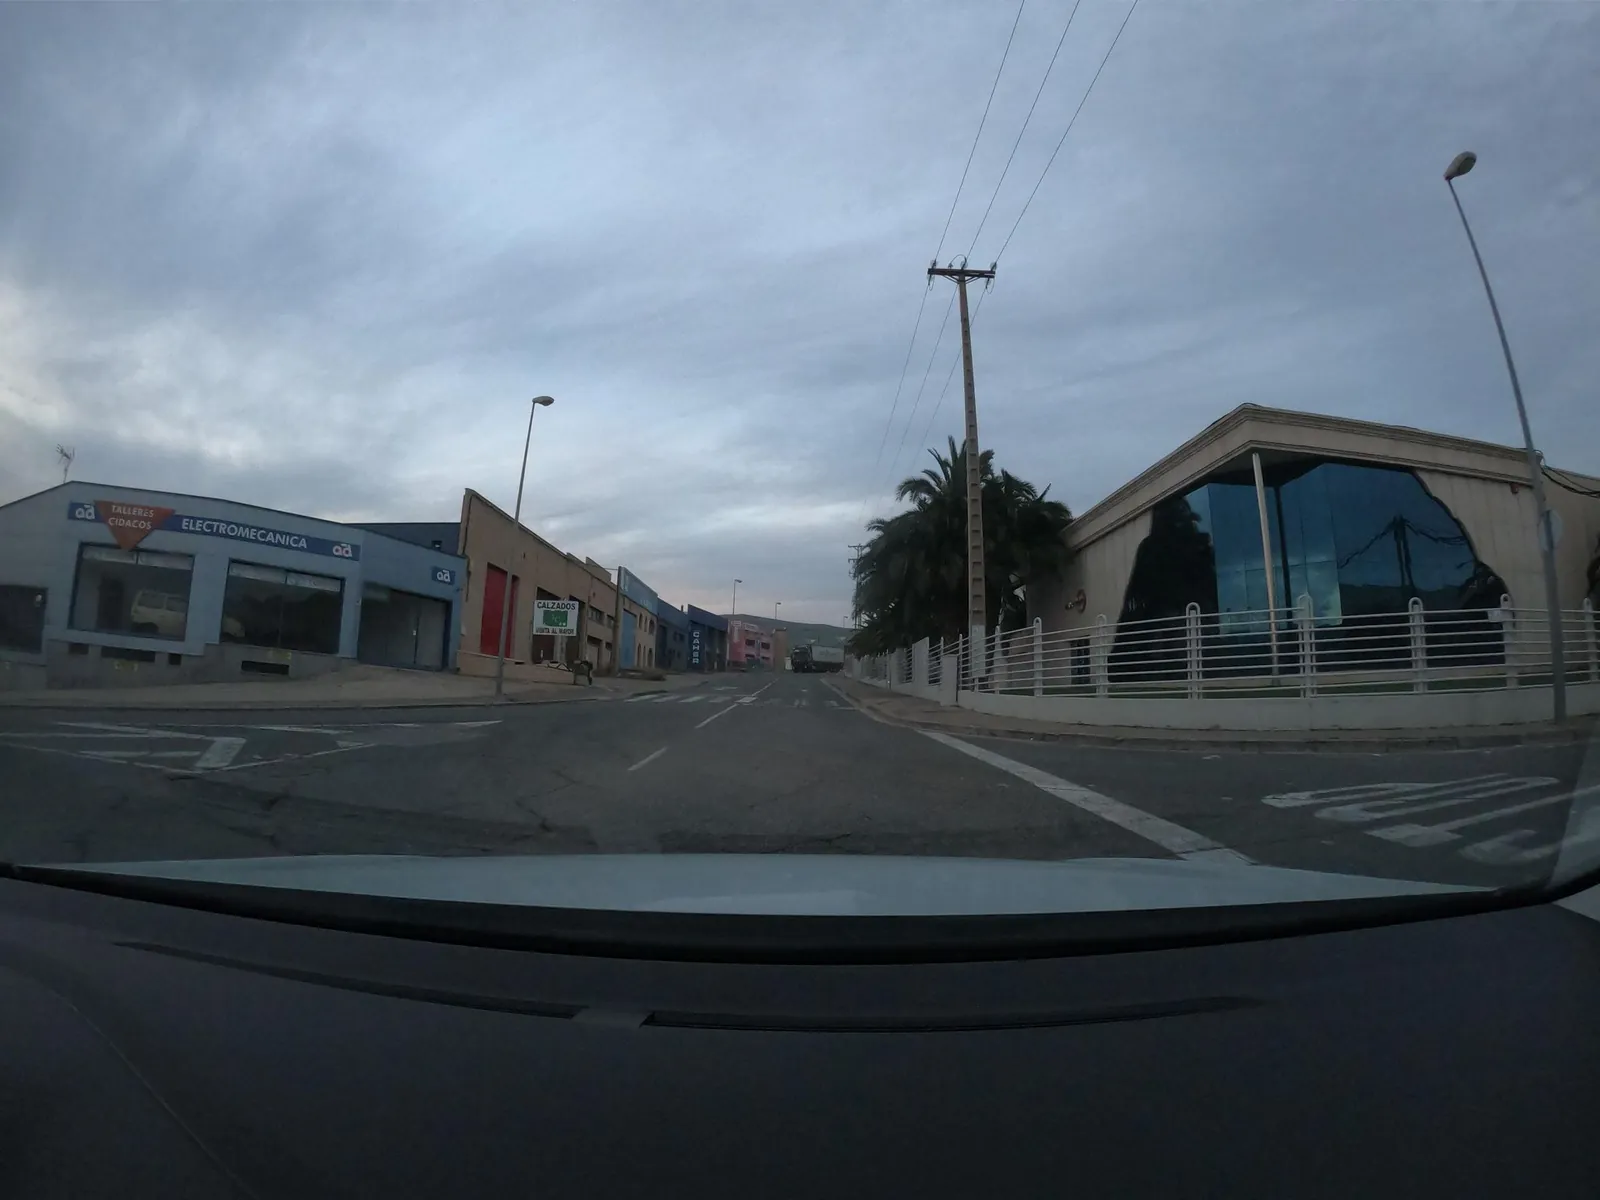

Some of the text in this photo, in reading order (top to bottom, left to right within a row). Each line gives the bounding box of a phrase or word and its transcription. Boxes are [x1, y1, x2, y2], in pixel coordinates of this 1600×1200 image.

[111, 504, 155, 518] TALLERES
[107, 516, 153, 530] CIDACOS
[181, 518, 308, 549] ELECTROMECANICA
[537, 601, 576, 610] CALZADOS
